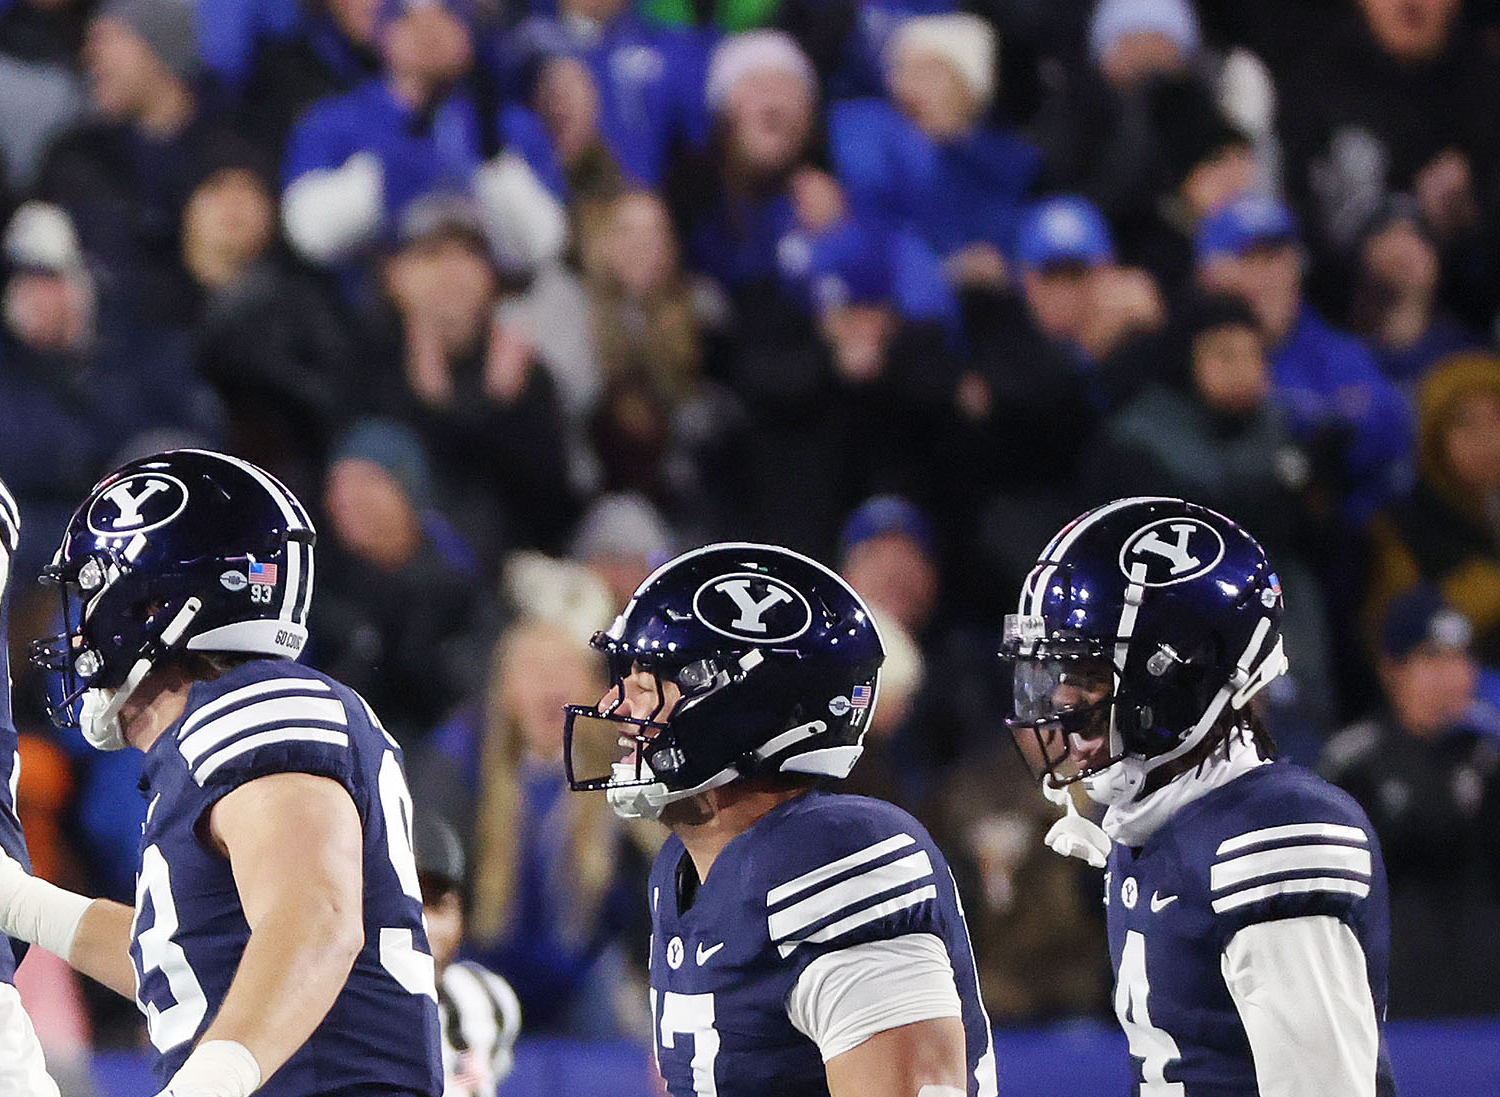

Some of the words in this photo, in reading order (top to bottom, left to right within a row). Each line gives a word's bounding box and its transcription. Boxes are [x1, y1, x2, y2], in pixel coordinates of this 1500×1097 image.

[102, 479, 170, 528] Y
[1132, 524, 1201, 576] Y
[250, 585, 273, 603] 93
[714, 579, 793, 633] Y
[274, 629, 289, 645] GO
